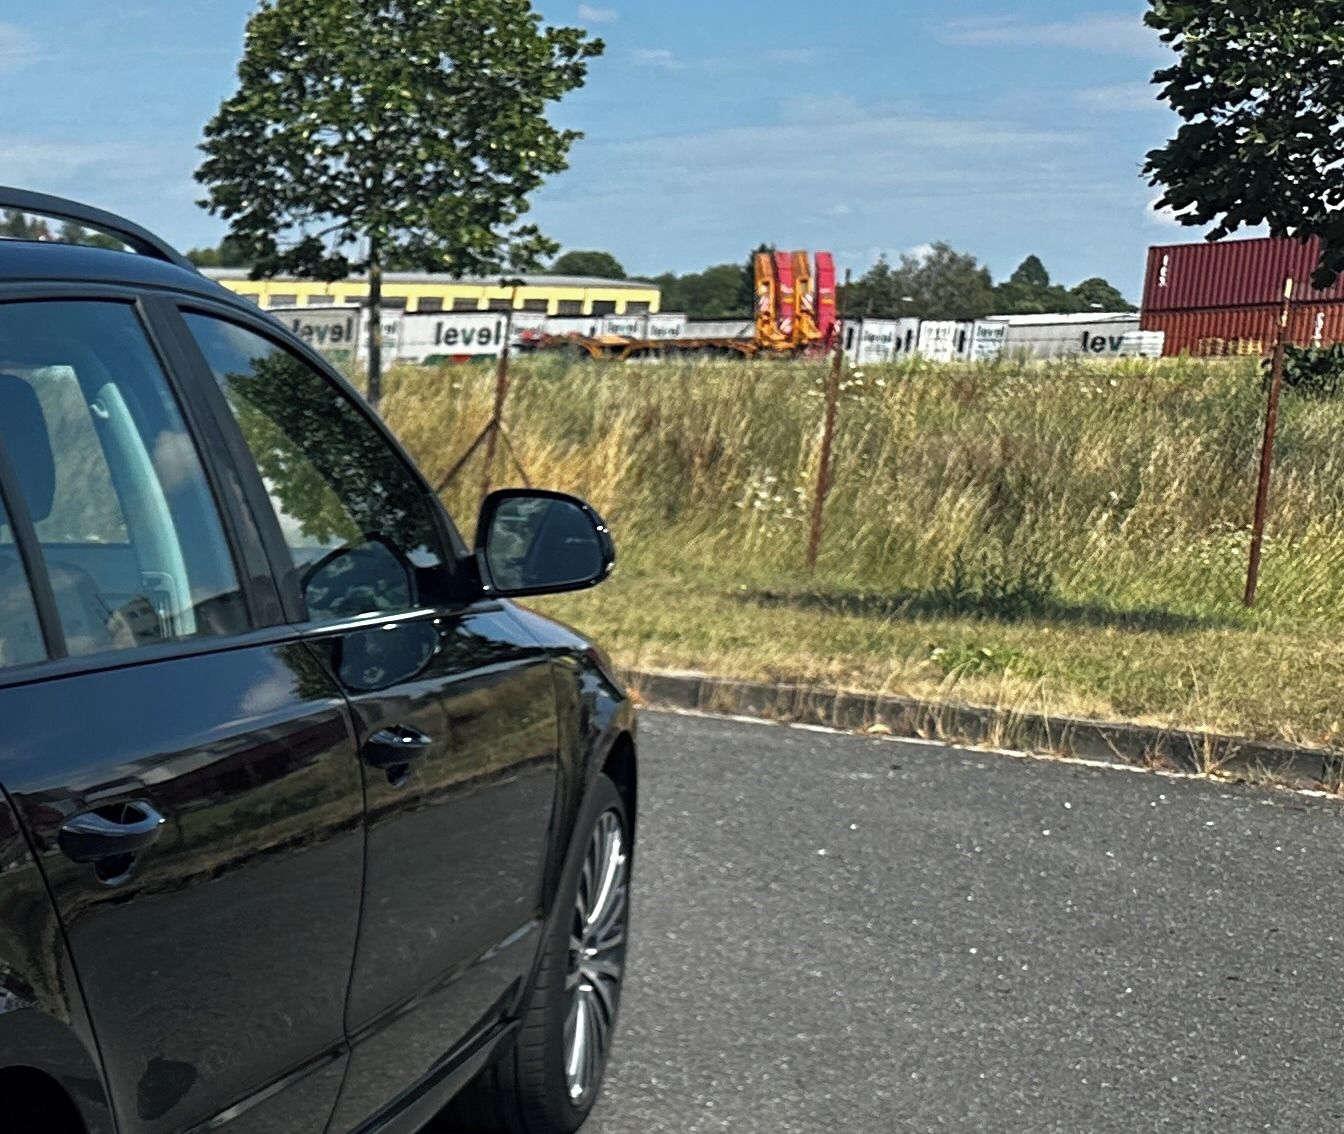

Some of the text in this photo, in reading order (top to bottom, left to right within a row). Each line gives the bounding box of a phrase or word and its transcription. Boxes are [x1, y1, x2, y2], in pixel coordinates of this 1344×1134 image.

[293, 318, 352, 344] level
[435, 320, 502, 346] level
[1081, 330, 1125, 353] lev
